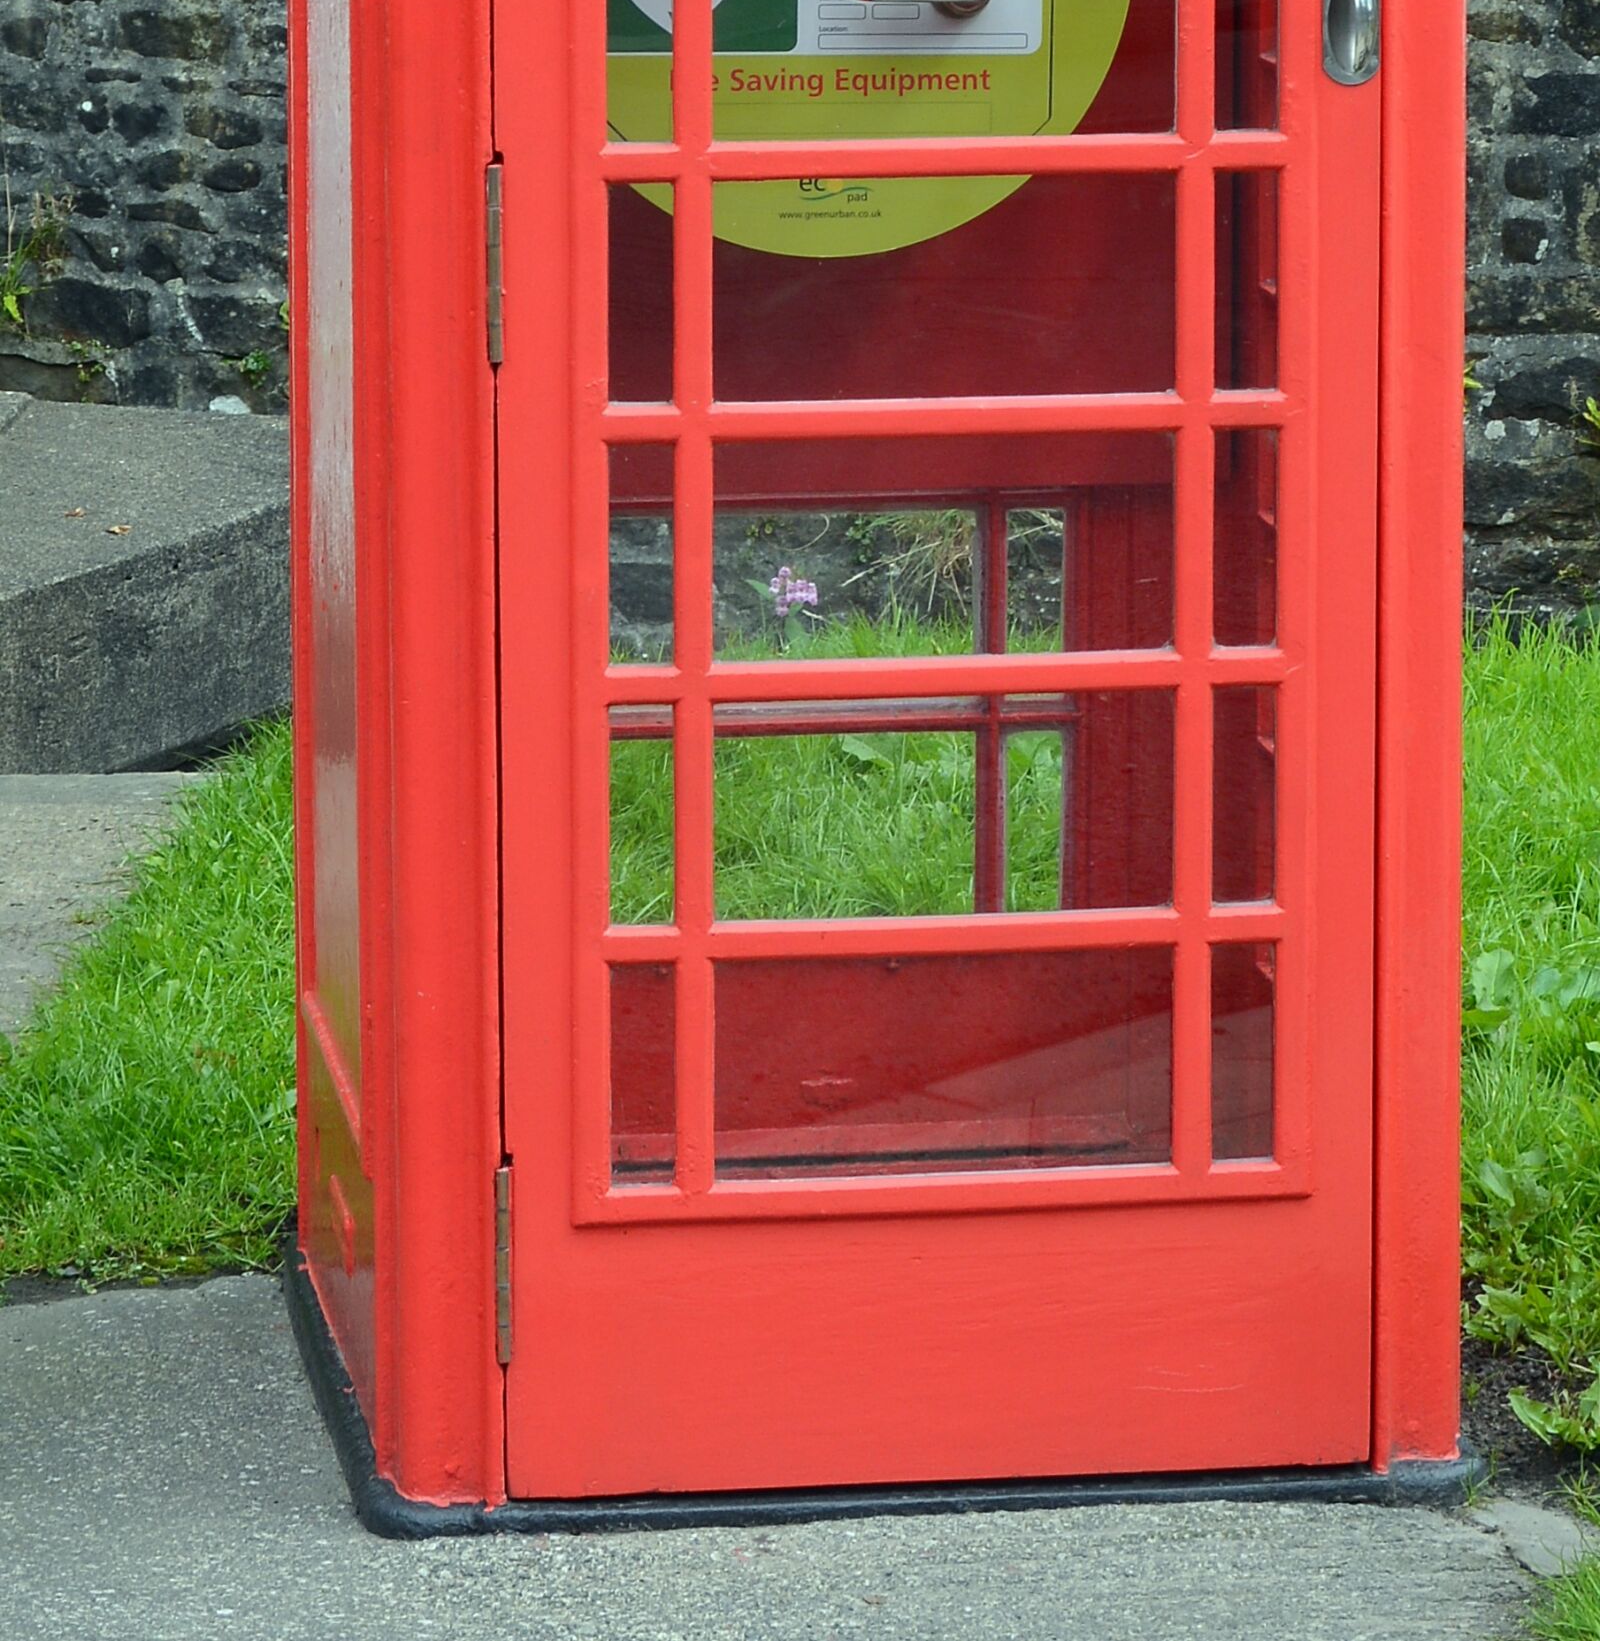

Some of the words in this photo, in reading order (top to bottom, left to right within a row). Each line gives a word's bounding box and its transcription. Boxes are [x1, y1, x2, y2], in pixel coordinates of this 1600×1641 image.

[730, 68, 824, 97] Saving
[835, 68, 991, 96] Equipment
[847, 191, 868, 204] pad
[779, 210, 882, 221] www.greenurban.co.uk
